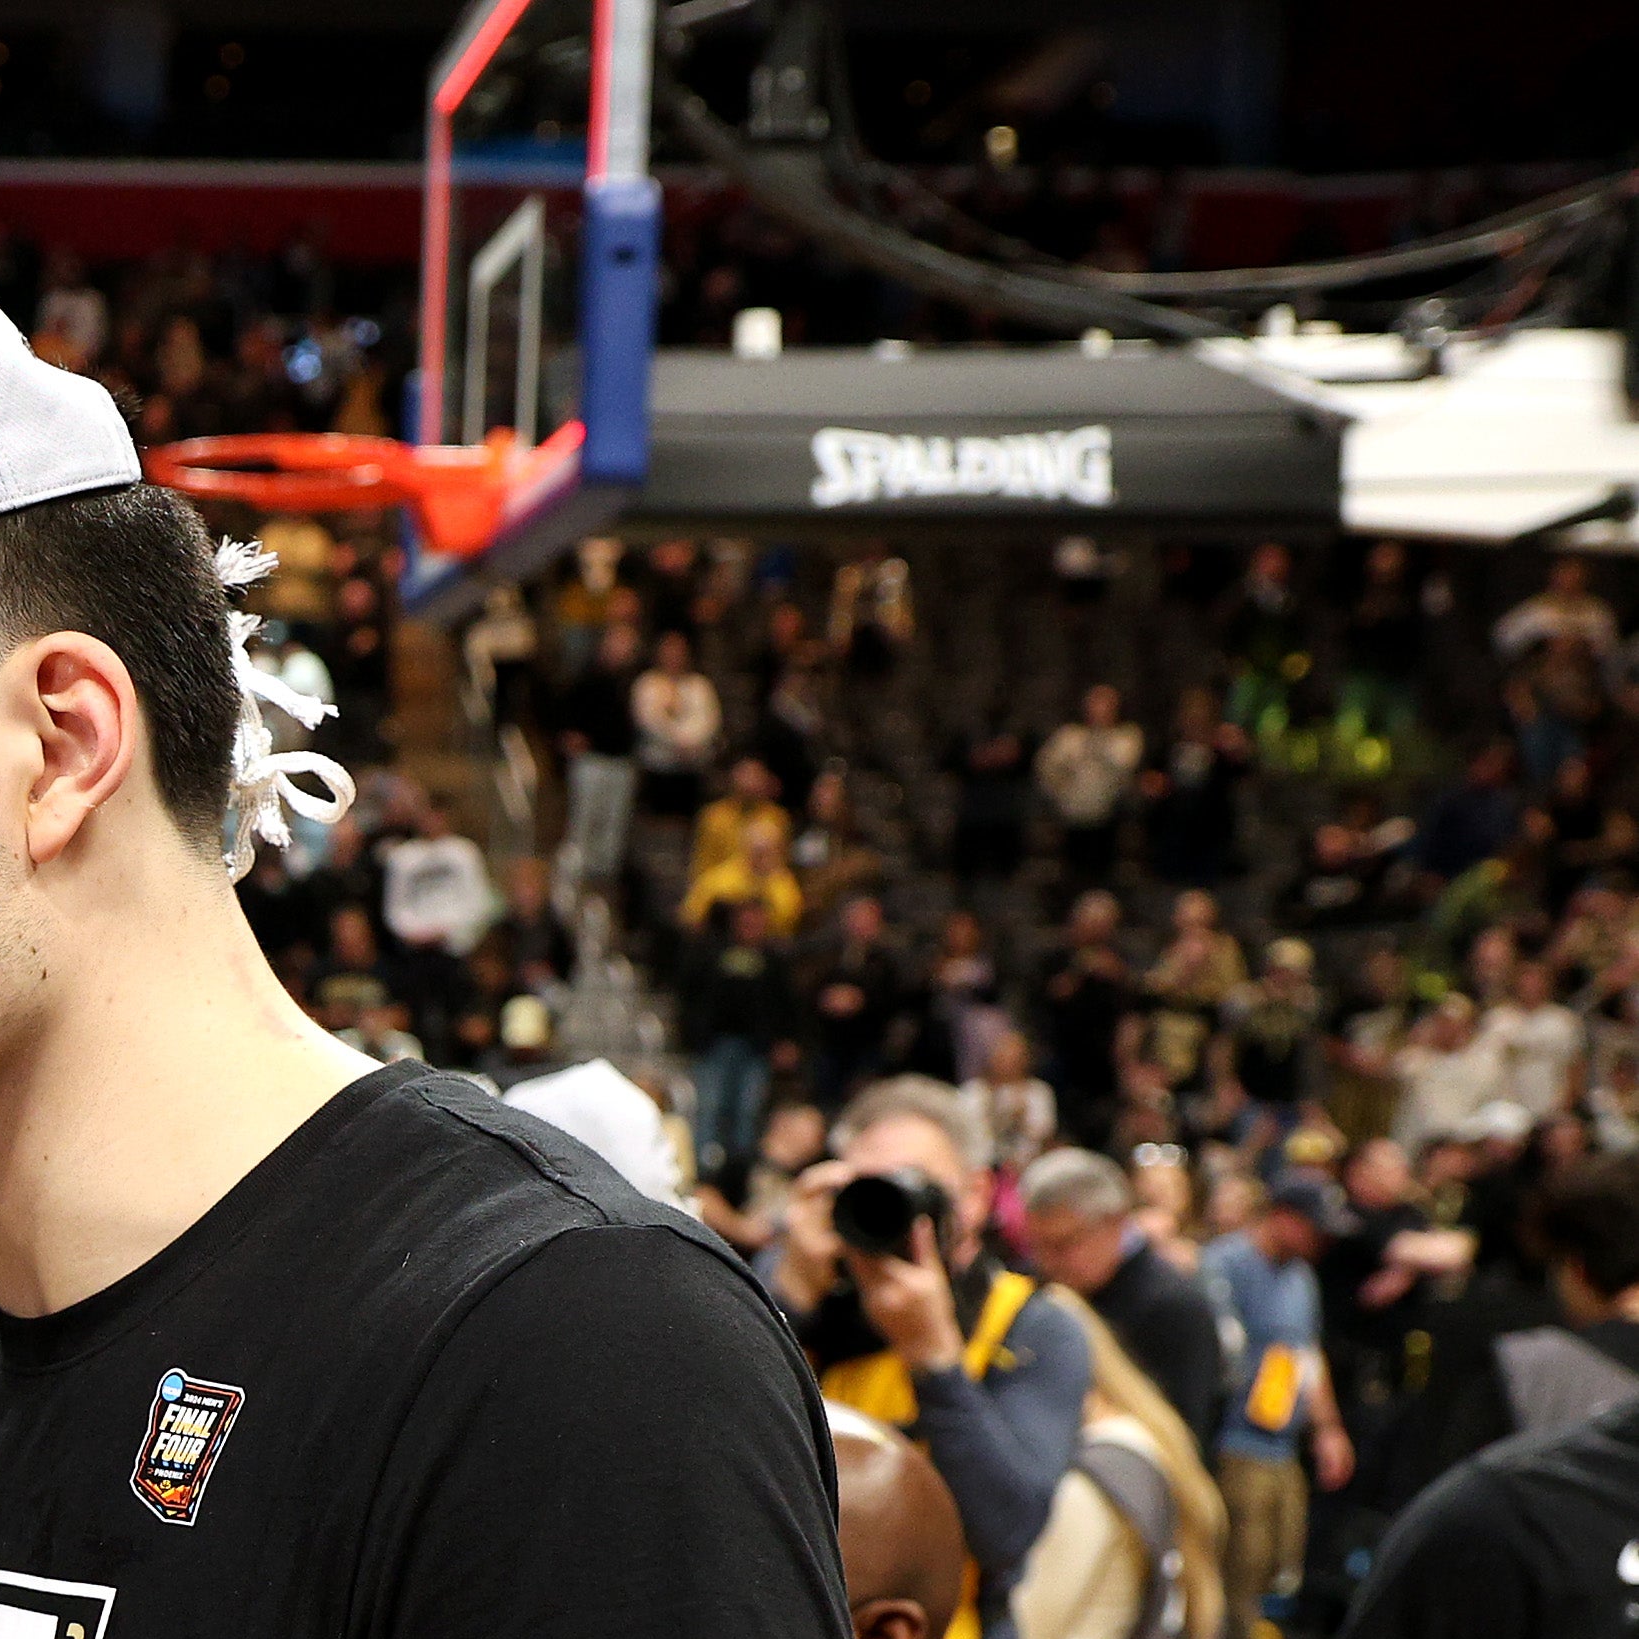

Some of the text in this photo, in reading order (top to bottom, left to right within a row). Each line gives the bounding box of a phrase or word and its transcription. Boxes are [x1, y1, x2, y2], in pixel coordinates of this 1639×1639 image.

[811, 425, 1114, 506] SPALDING
[159, 1403, 218, 1439] FINAL
[151, 1432, 206, 1466] FOUR
[154, 1468, 185, 1480] PHOENIX
